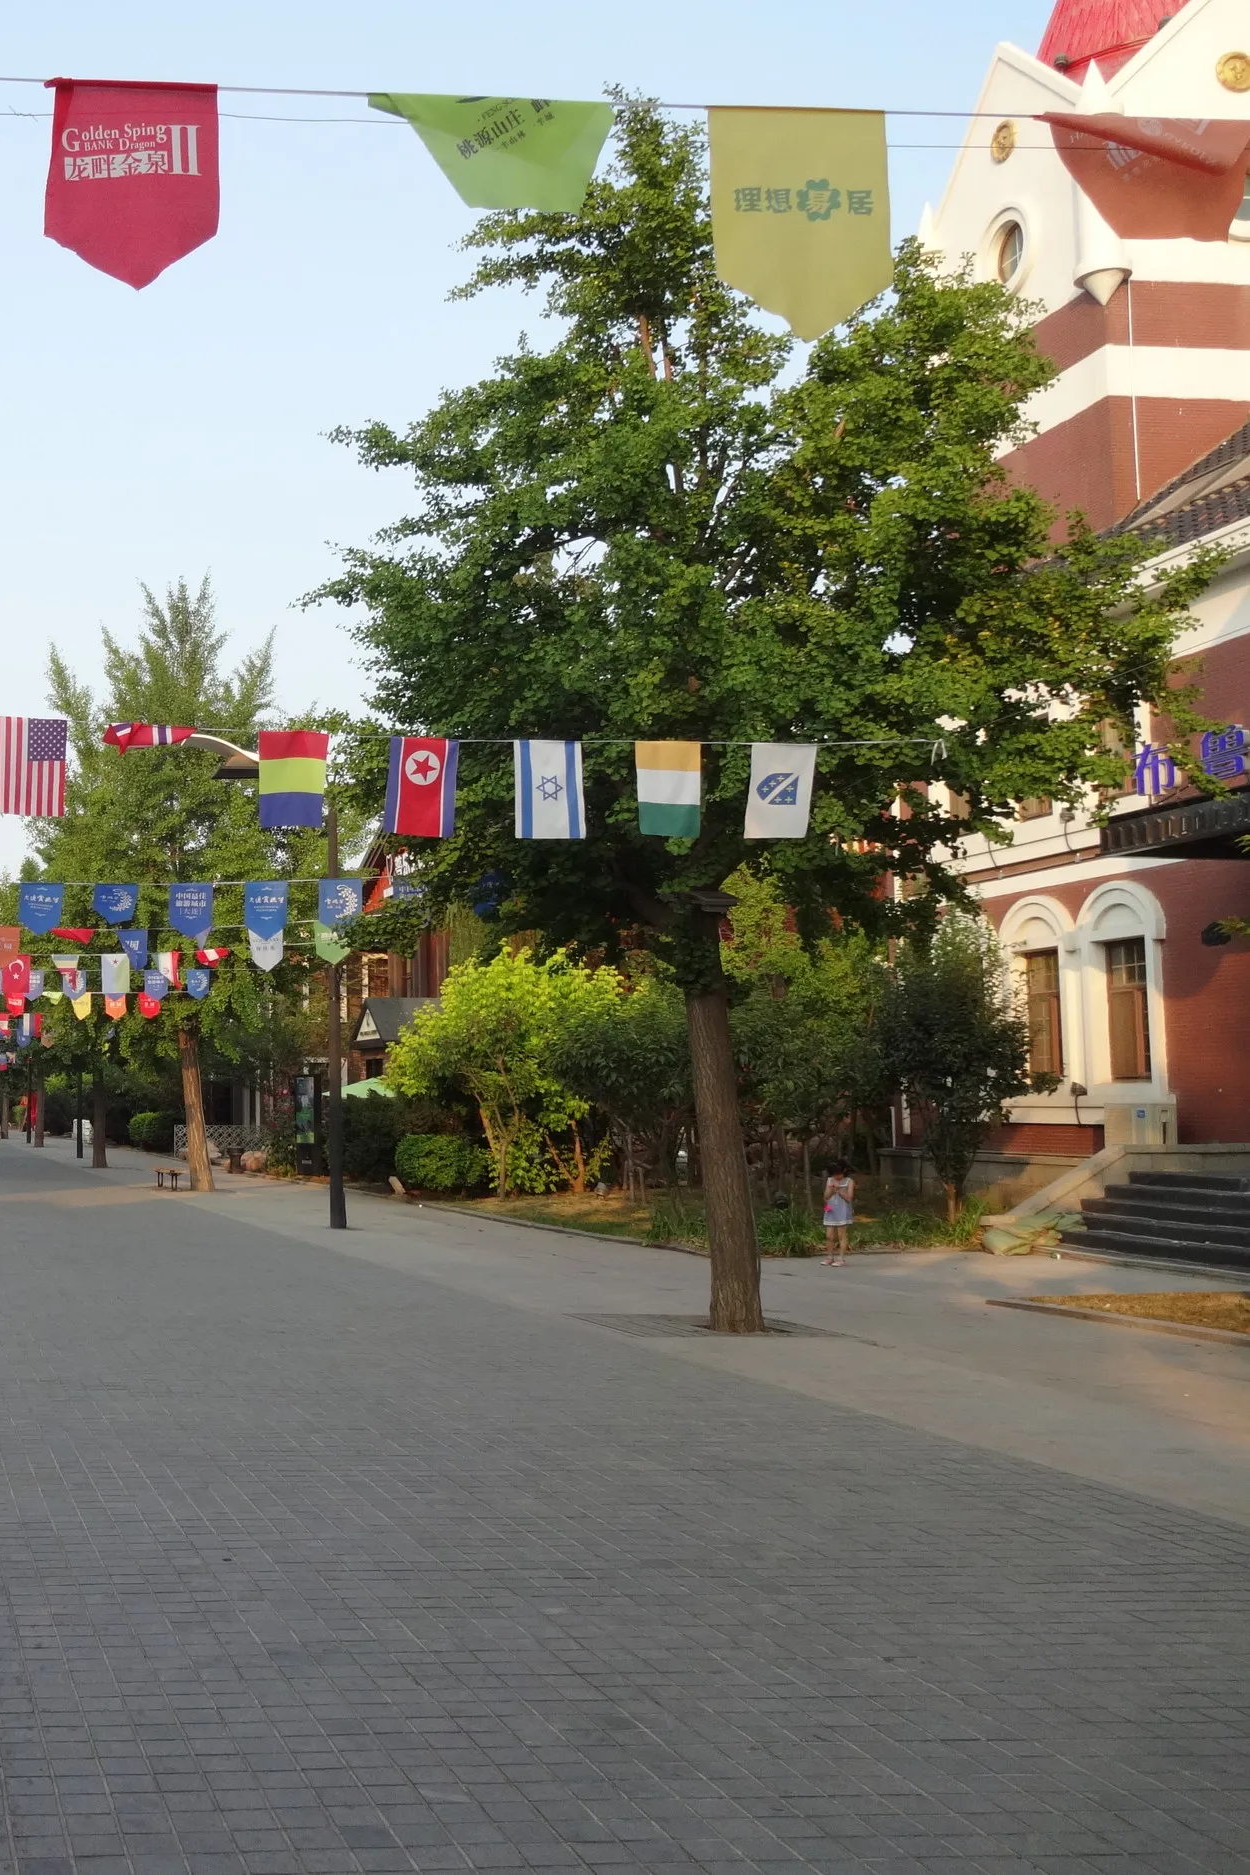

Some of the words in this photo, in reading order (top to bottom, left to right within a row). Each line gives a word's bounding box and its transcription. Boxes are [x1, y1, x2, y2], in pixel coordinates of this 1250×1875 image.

[61, 125, 119, 152] Golden
[84, 139, 113, 152] BANK
[119, 138, 156, 151] Dragon
[456, 108, 525, 160] 桃源山庄
